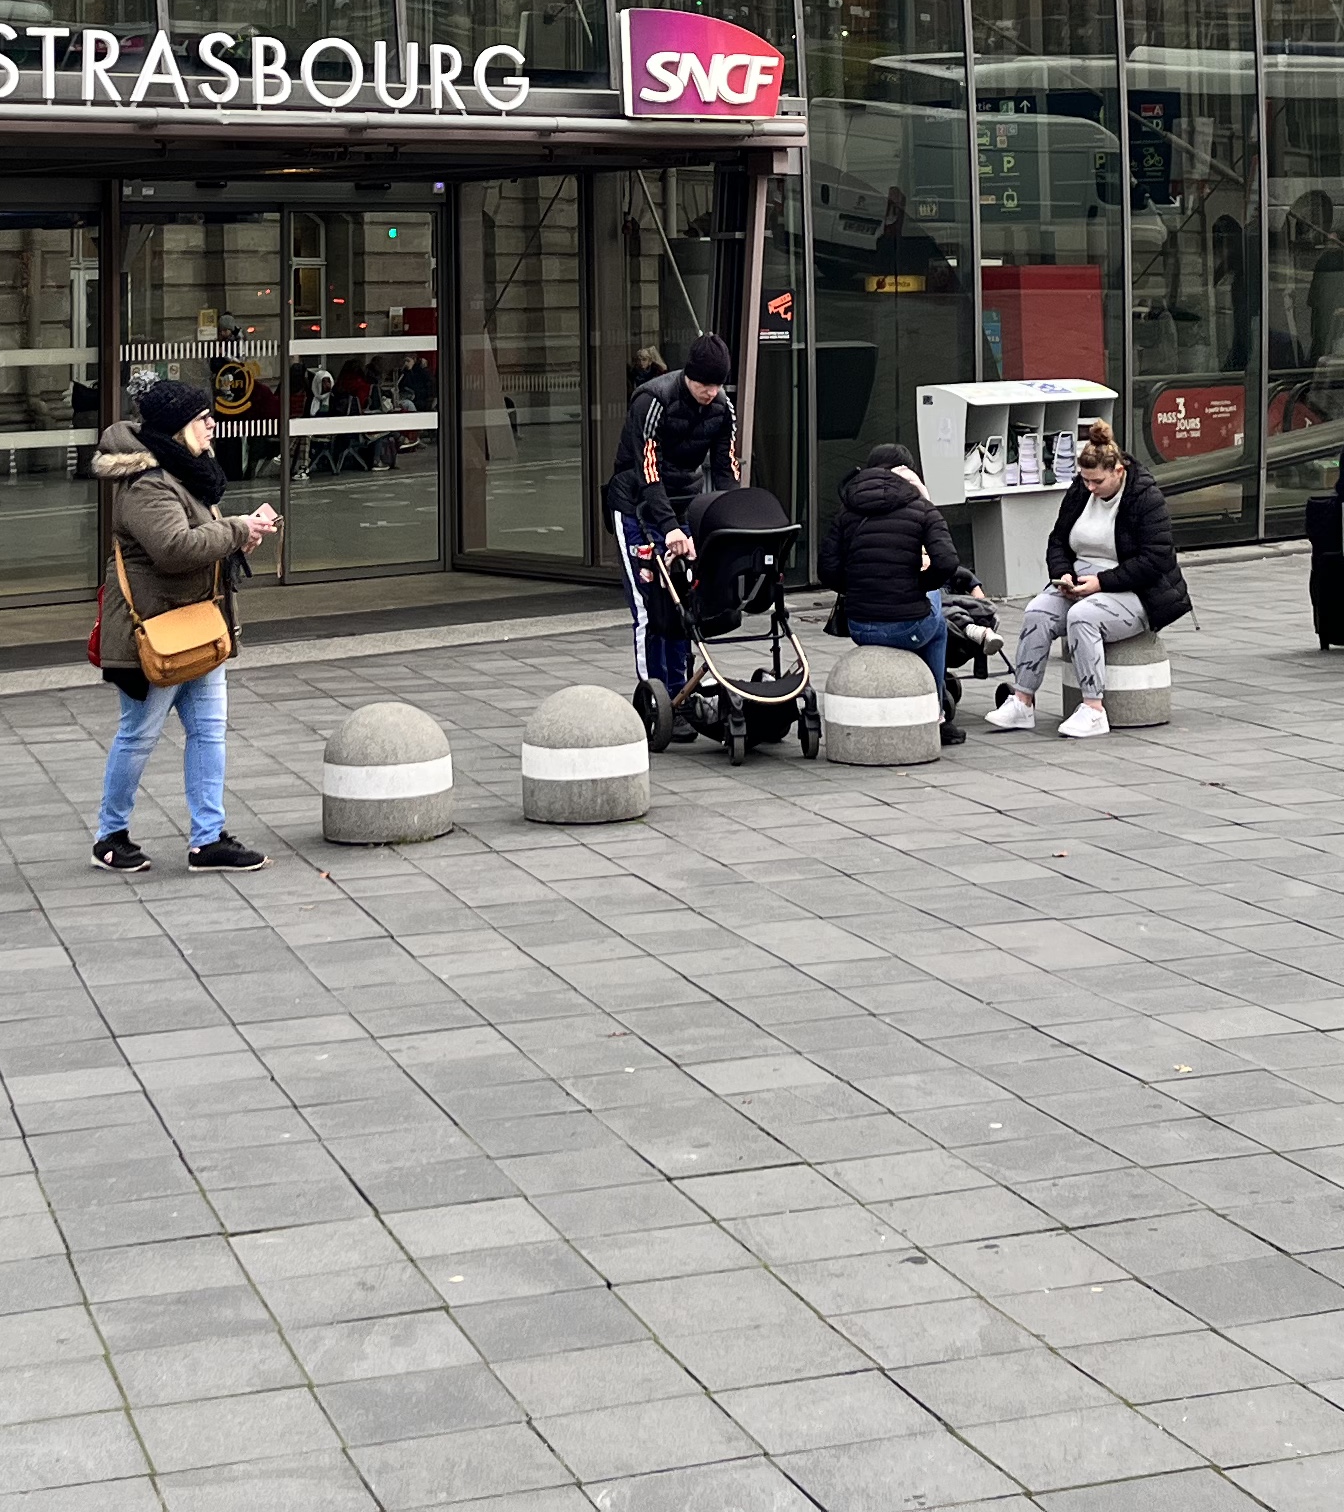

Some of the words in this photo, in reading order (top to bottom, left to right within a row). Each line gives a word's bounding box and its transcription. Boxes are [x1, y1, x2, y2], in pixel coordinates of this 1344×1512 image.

[640, 50, 780, 105] SNCF
[1157, 412, 1176, 424] PASS
[1176, 398, 1185, 418] 3
[1176, 418, 1200, 430] JOURS
